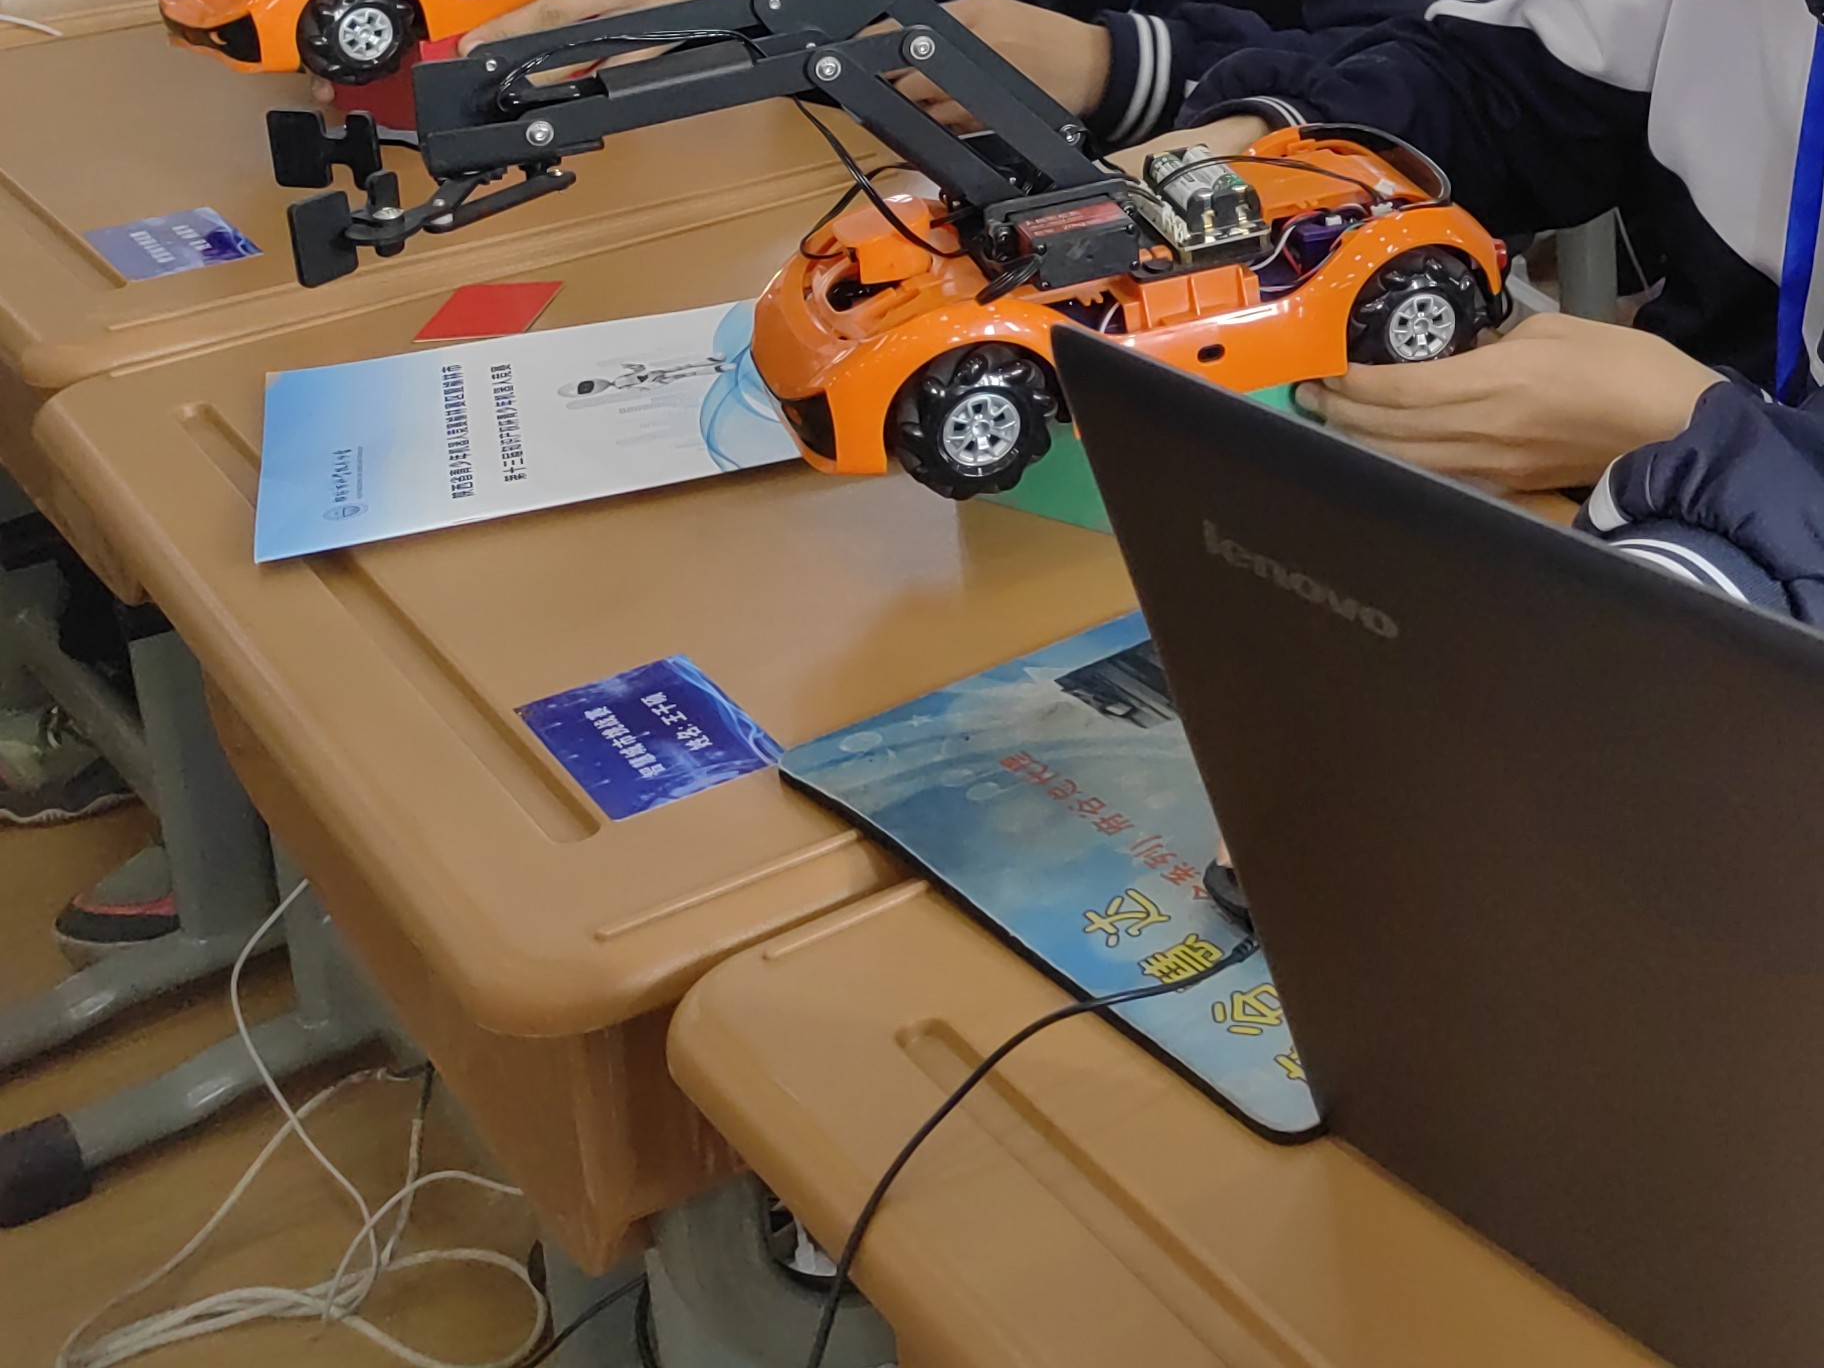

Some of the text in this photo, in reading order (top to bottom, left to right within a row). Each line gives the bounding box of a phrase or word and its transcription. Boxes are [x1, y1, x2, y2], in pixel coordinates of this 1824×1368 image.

[1202, 518, 1400, 639] lenovo
[583, 705, 667, 780] 智慧城市挑战赛
